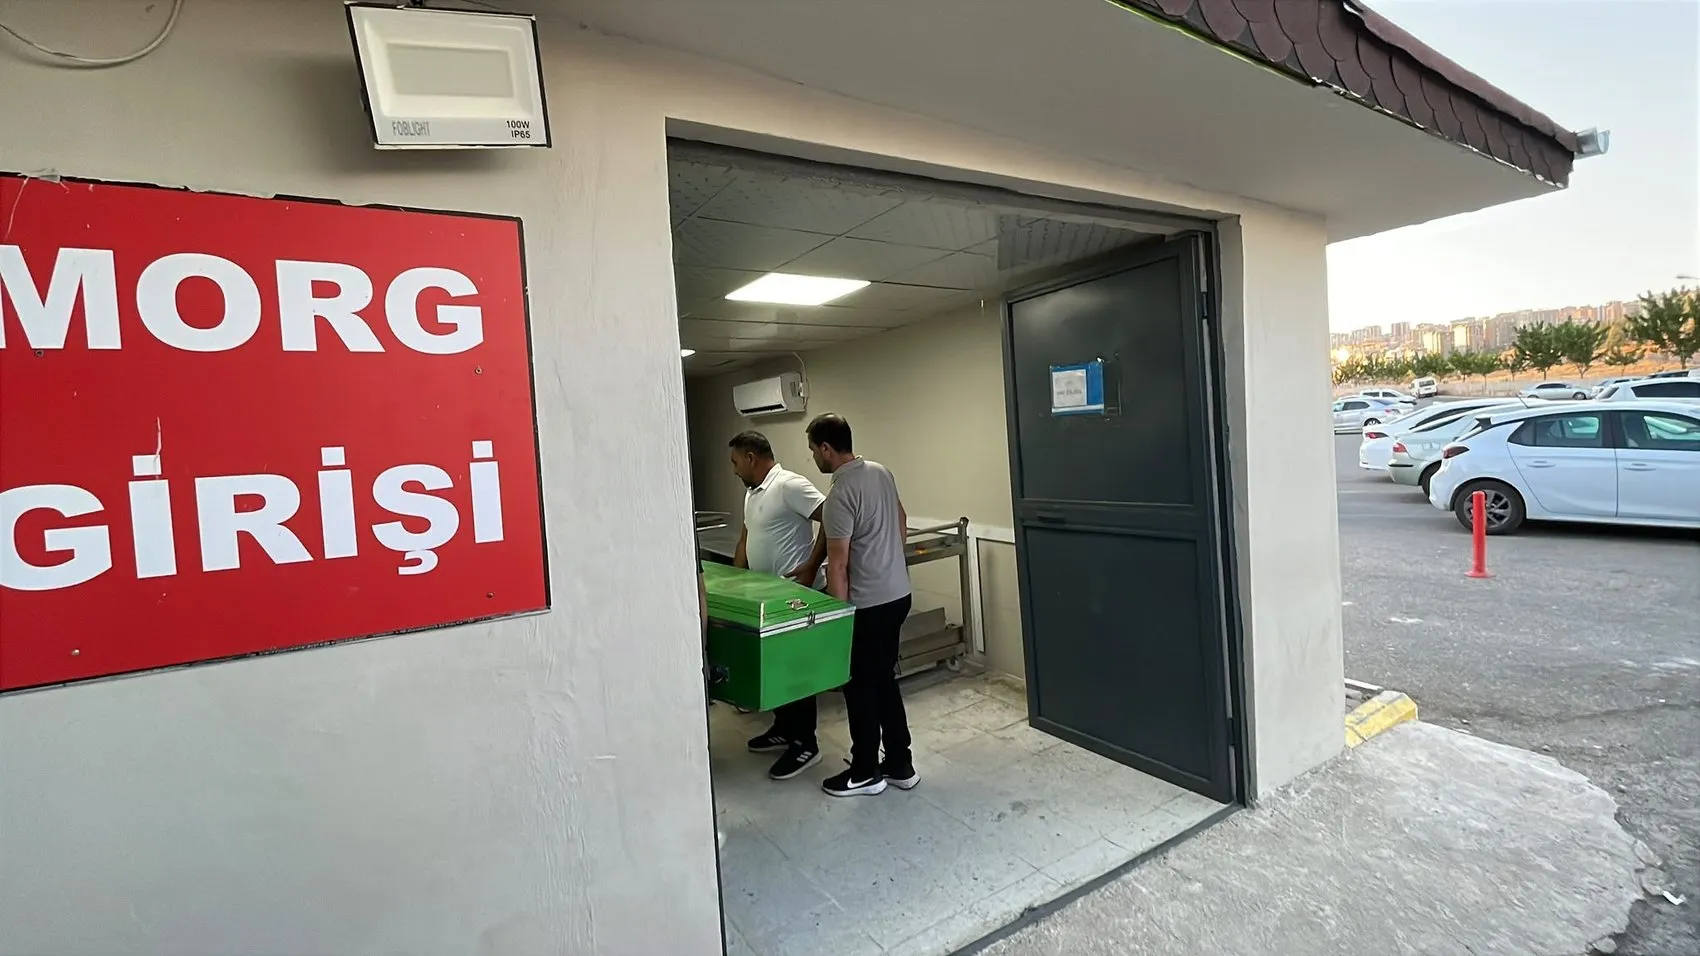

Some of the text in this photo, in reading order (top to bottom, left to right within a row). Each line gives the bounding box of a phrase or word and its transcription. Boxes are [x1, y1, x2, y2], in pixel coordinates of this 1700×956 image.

[506, 120, 530, 129] 100W
[511, 129, 531, 139] IP65
[0, 244, 484, 354] MORG
[0, 440, 505, 591] GİRİŞİ
